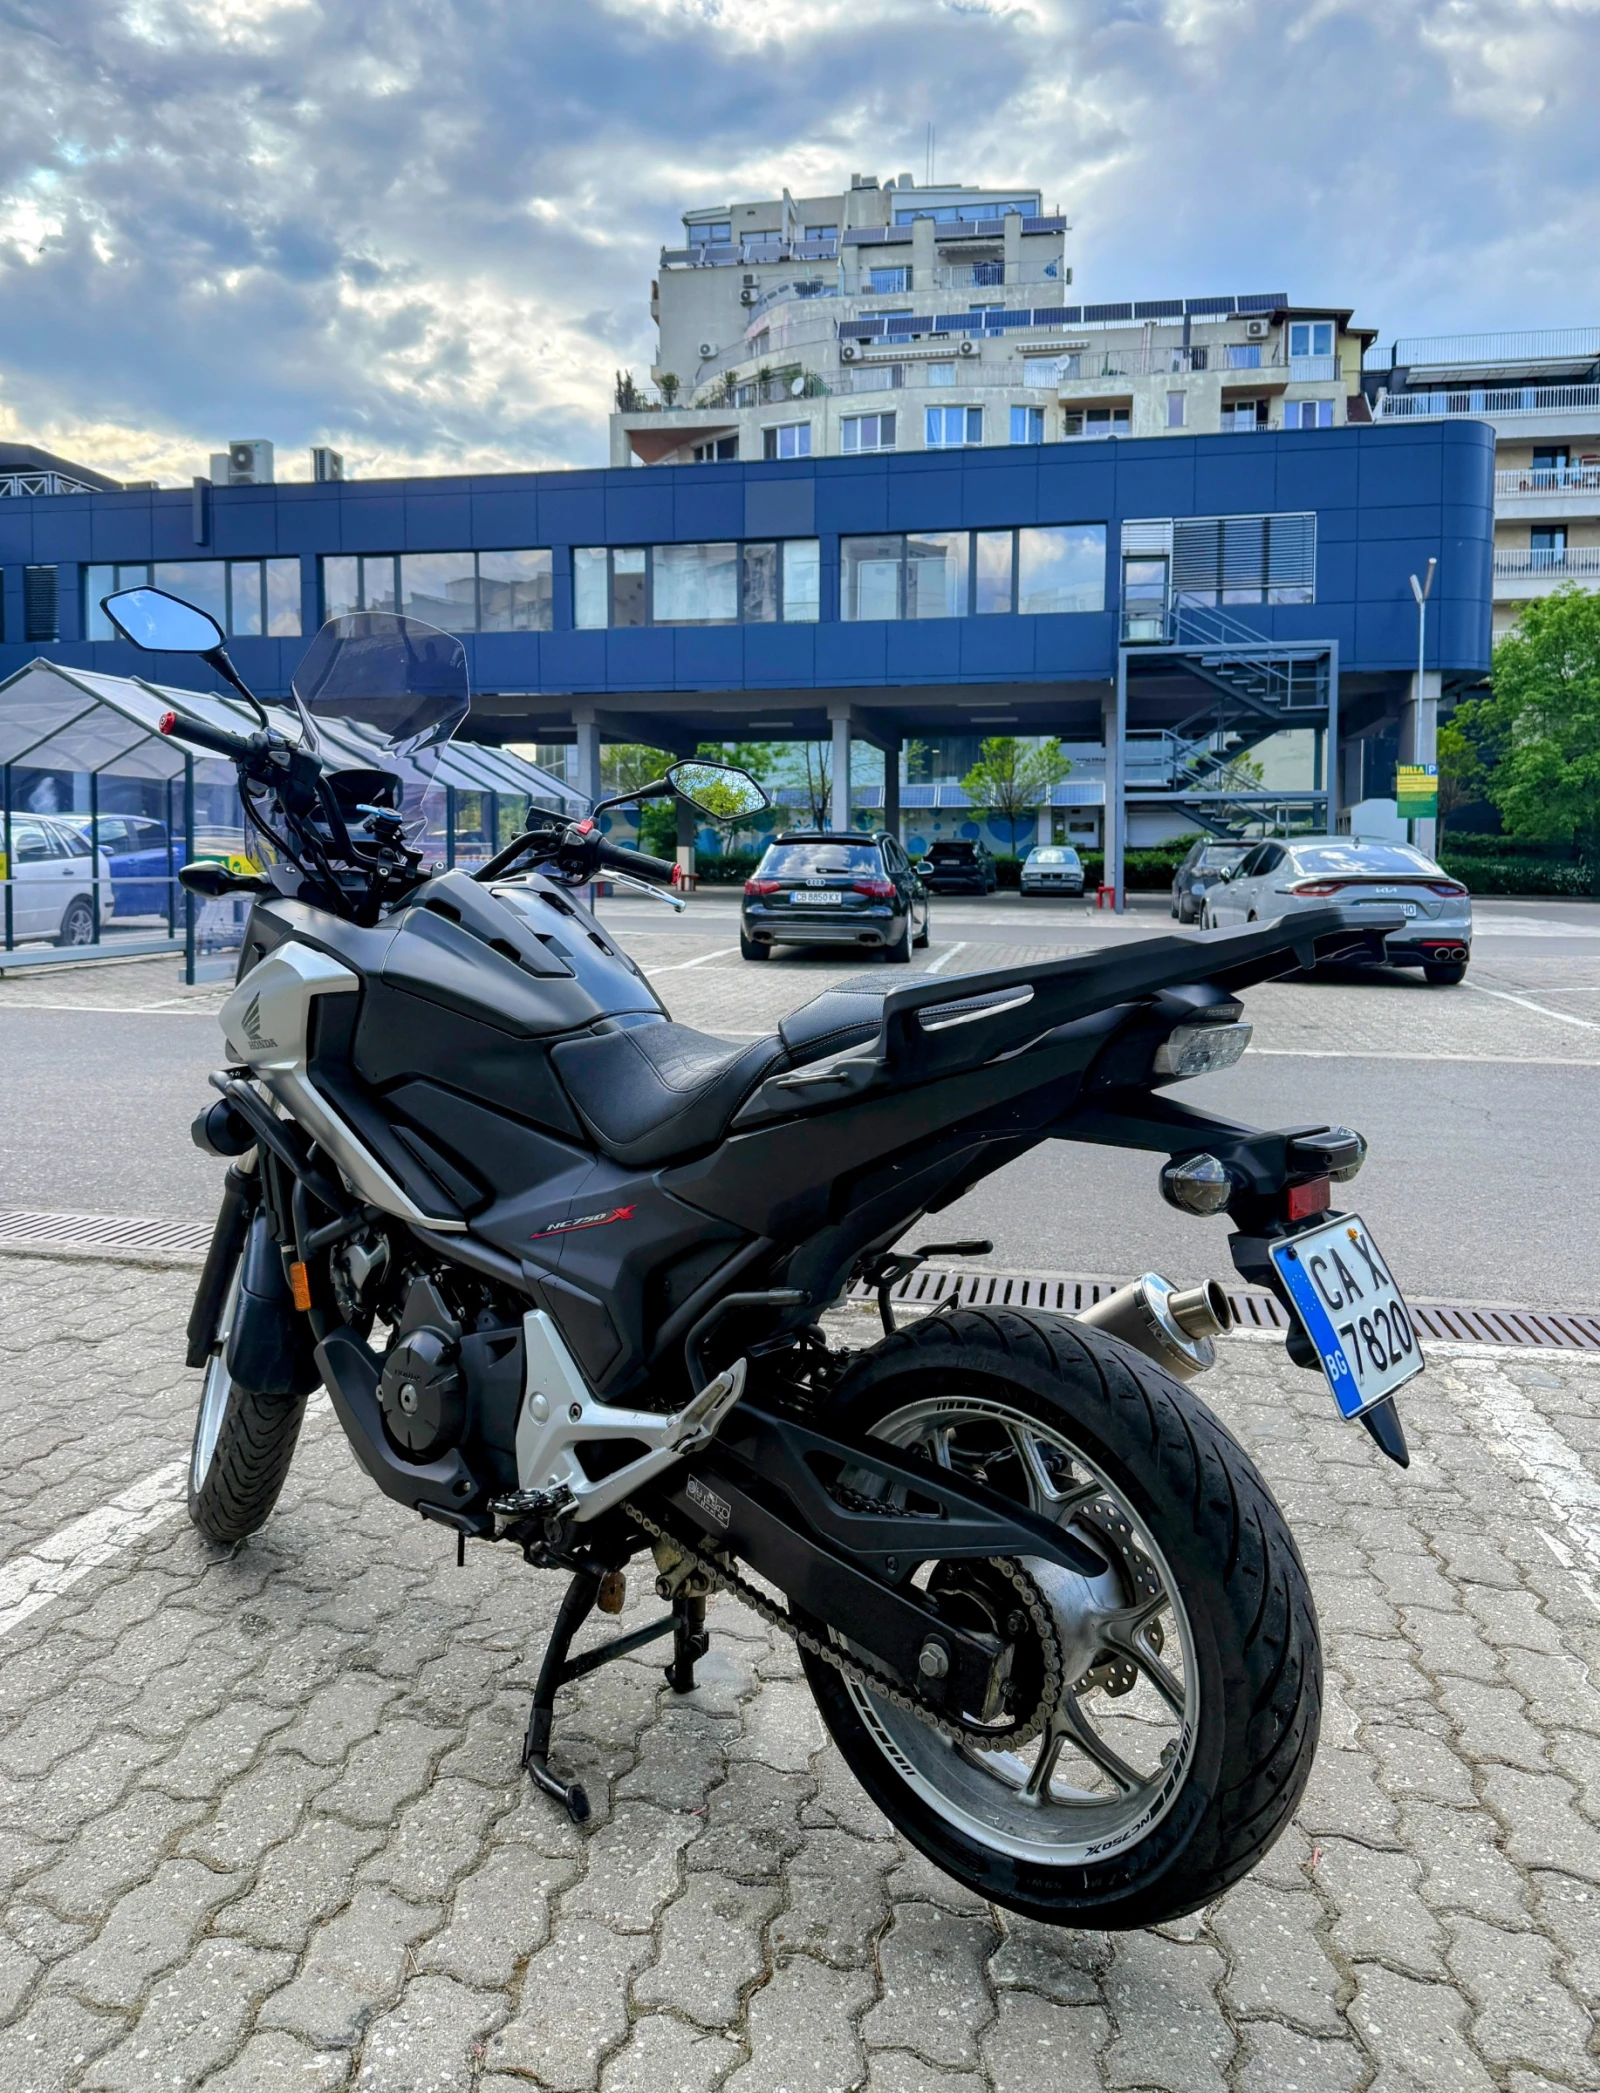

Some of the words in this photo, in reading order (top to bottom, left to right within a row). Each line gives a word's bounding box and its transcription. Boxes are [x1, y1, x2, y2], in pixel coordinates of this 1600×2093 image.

[1399, 766, 1425, 775] BILLA
[1428, 765, 1437, 775] P
[797, 893, 807, 902] CB
[808, 893, 828, 902] 8850
[830, 893, 840, 902] KX
[248, 1038, 279, 1050] HONDA
[1309, 1247, 1365, 1311] CA
[1350, 1233, 1390, 1292] X
[1337, 1299, 1412, 1386] 7820
[1325, 1350, 1348, 1382] BG
[1085, 1813, 1152, 1858] NC750X
